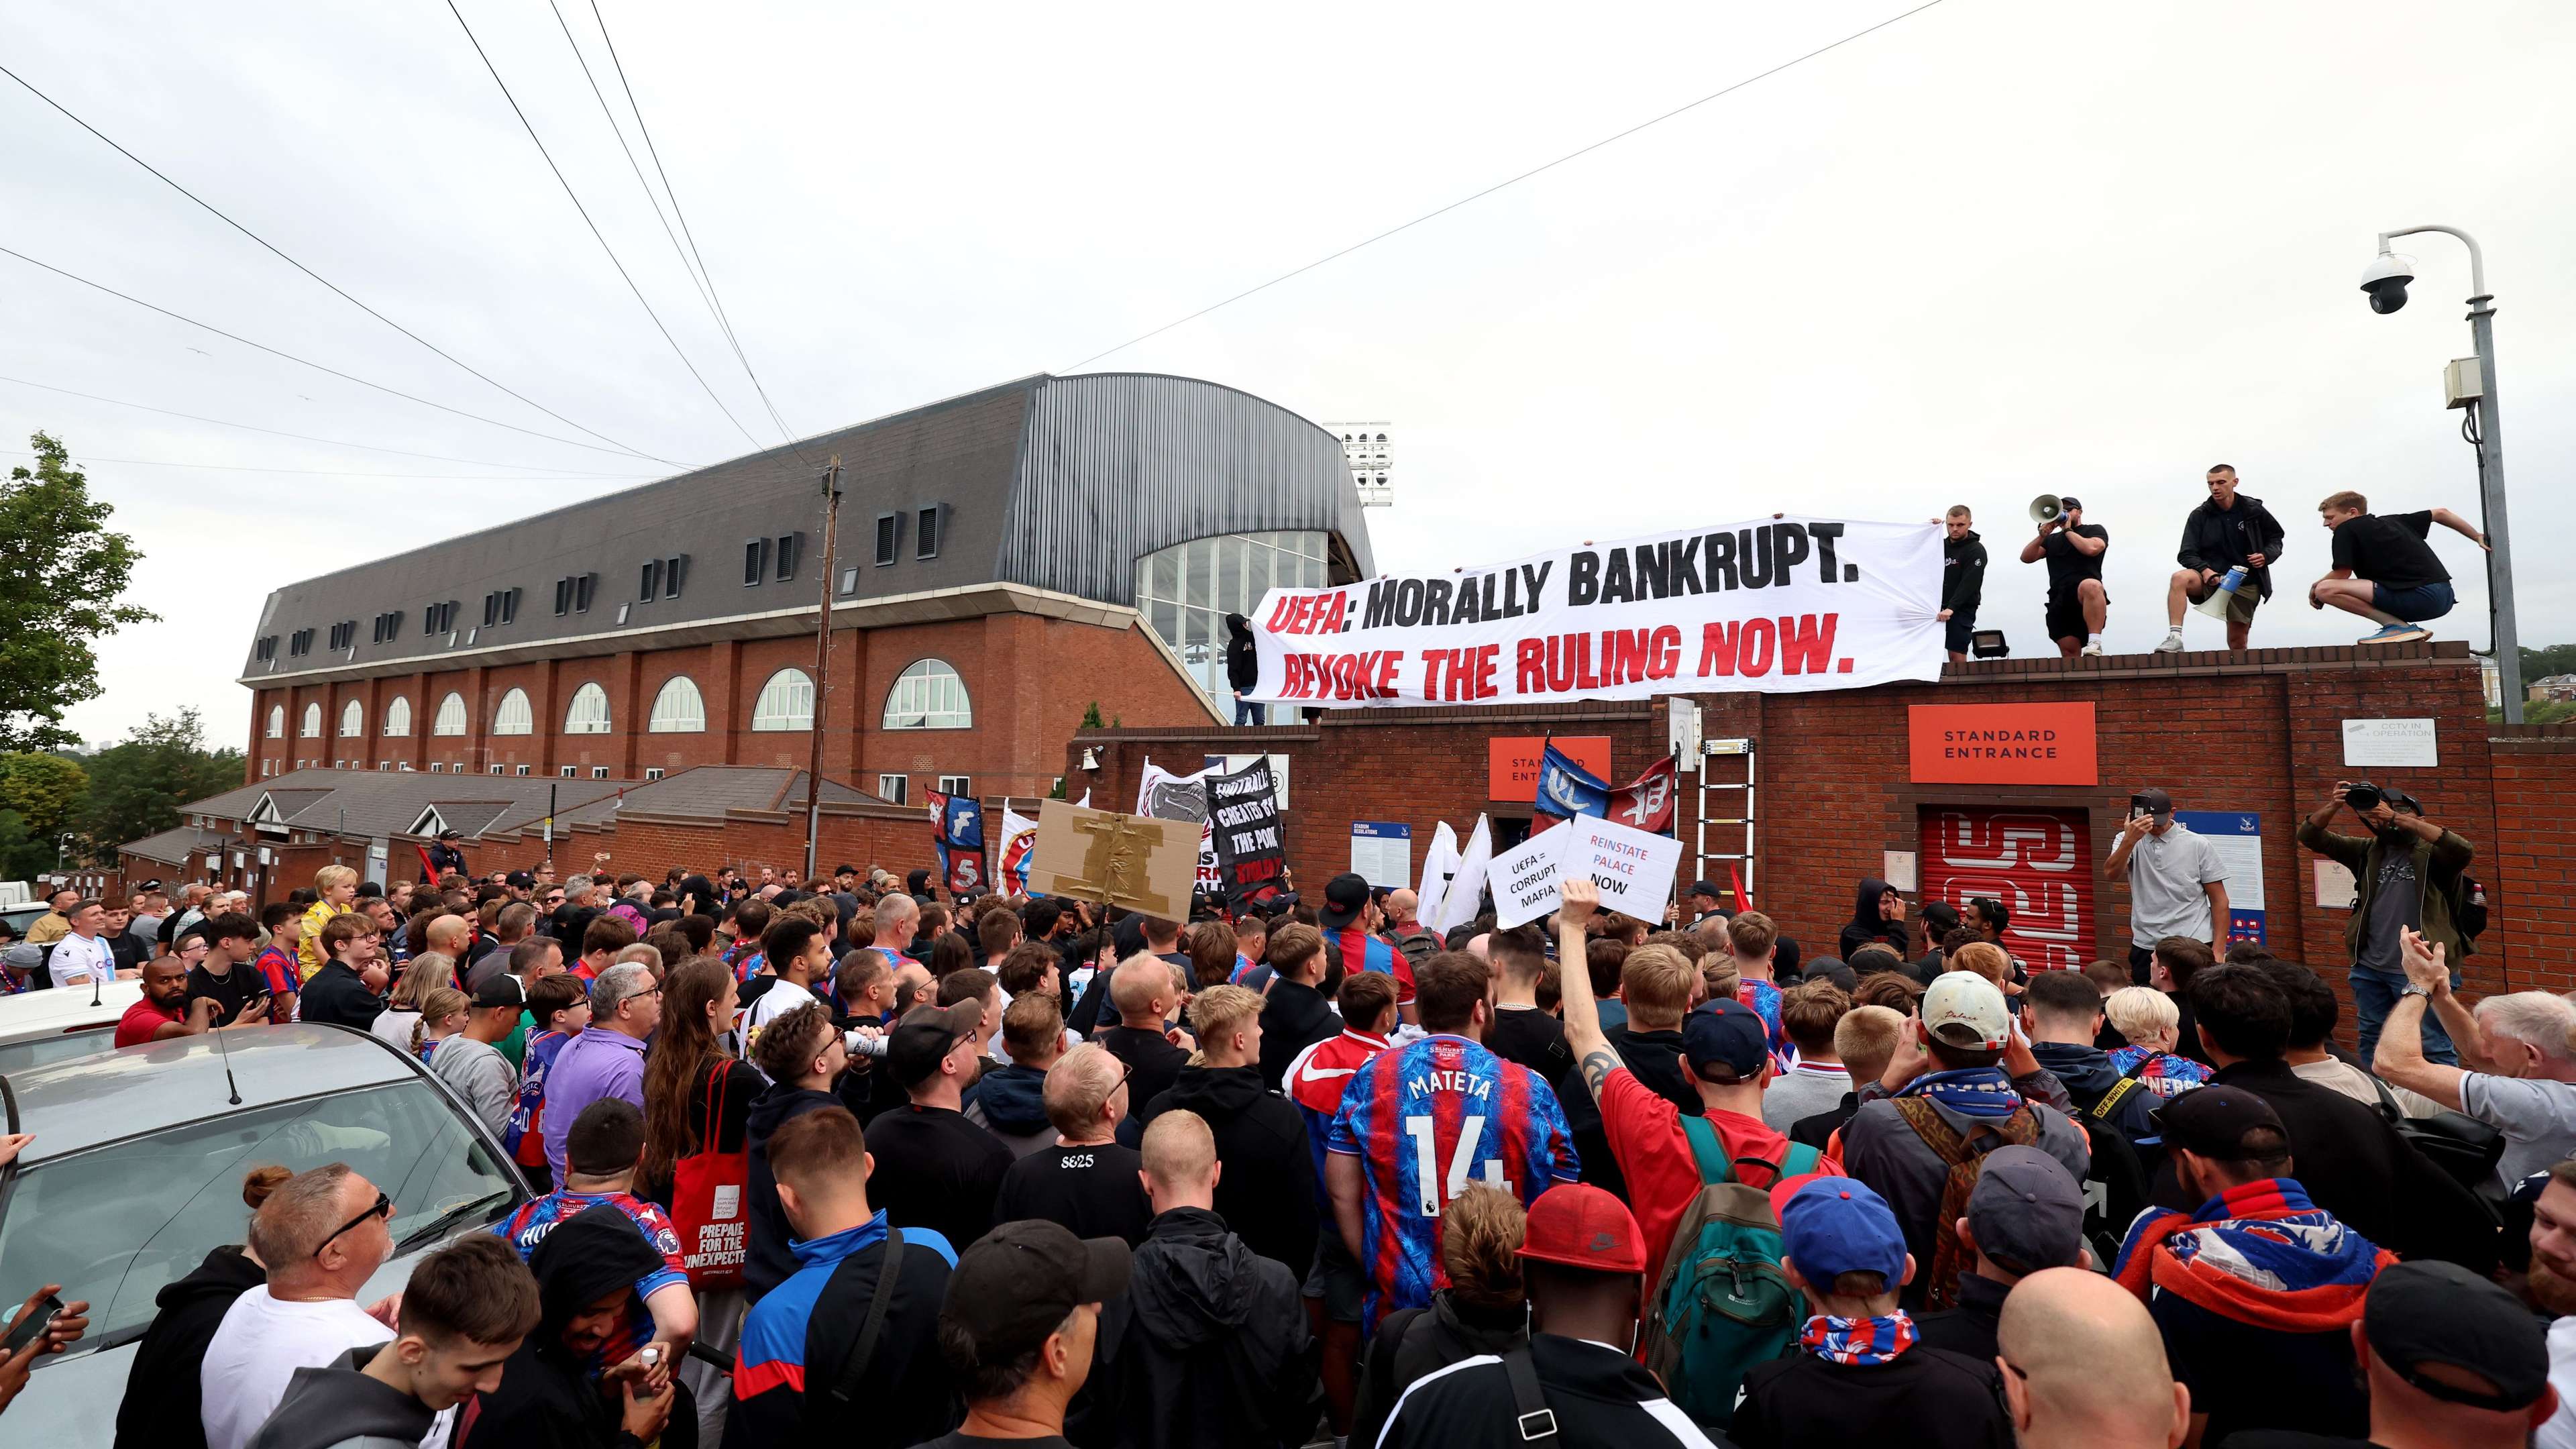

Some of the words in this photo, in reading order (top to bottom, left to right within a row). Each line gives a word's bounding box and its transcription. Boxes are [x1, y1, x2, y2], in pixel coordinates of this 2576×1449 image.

[1267, 590, 1357, 635] UEFA:
[1362, 561, 1553, 629] MORALLY
[1568, 523, 1859, 606] BANKRUPT.
[1277, 650, 1403, 700] REVOKE
[1421, 644, 1499, 701] THE
[1516, 625, 1681, 694] RULING
[1697, 613, 1854, 678] NOW.
[1945, 730, 2056, 741] STANDARD
[1512, 759, 1585, 767] STAND
[1945, 747, 2057, 758] ENTRANCE
[1217, 800, 1265, 827] CREATED
[1231, 830, 1256, 855] THE
[1591, 835, 1648, 861] REINSTATE
[1511, 855, 1538, 874] U€FA
[1593, 854, 1635, 875] PALACE
[1510, 863, 1556, 894] CORRUPT
[1591, 873, 1628, 895] NOW
[1521, 885, 1556, 908] MAFIA
[1408, 1071, 1491, 1101] MATETA
[1061, 1154, 1094, 1169] SE25
[1405, 1116, 1513, 1217] 14
[556, 1201, 590, 1210] SELHURST
[699, 1238, 723, 1253] FOR
[724, 1236, 743, 1251] THE
